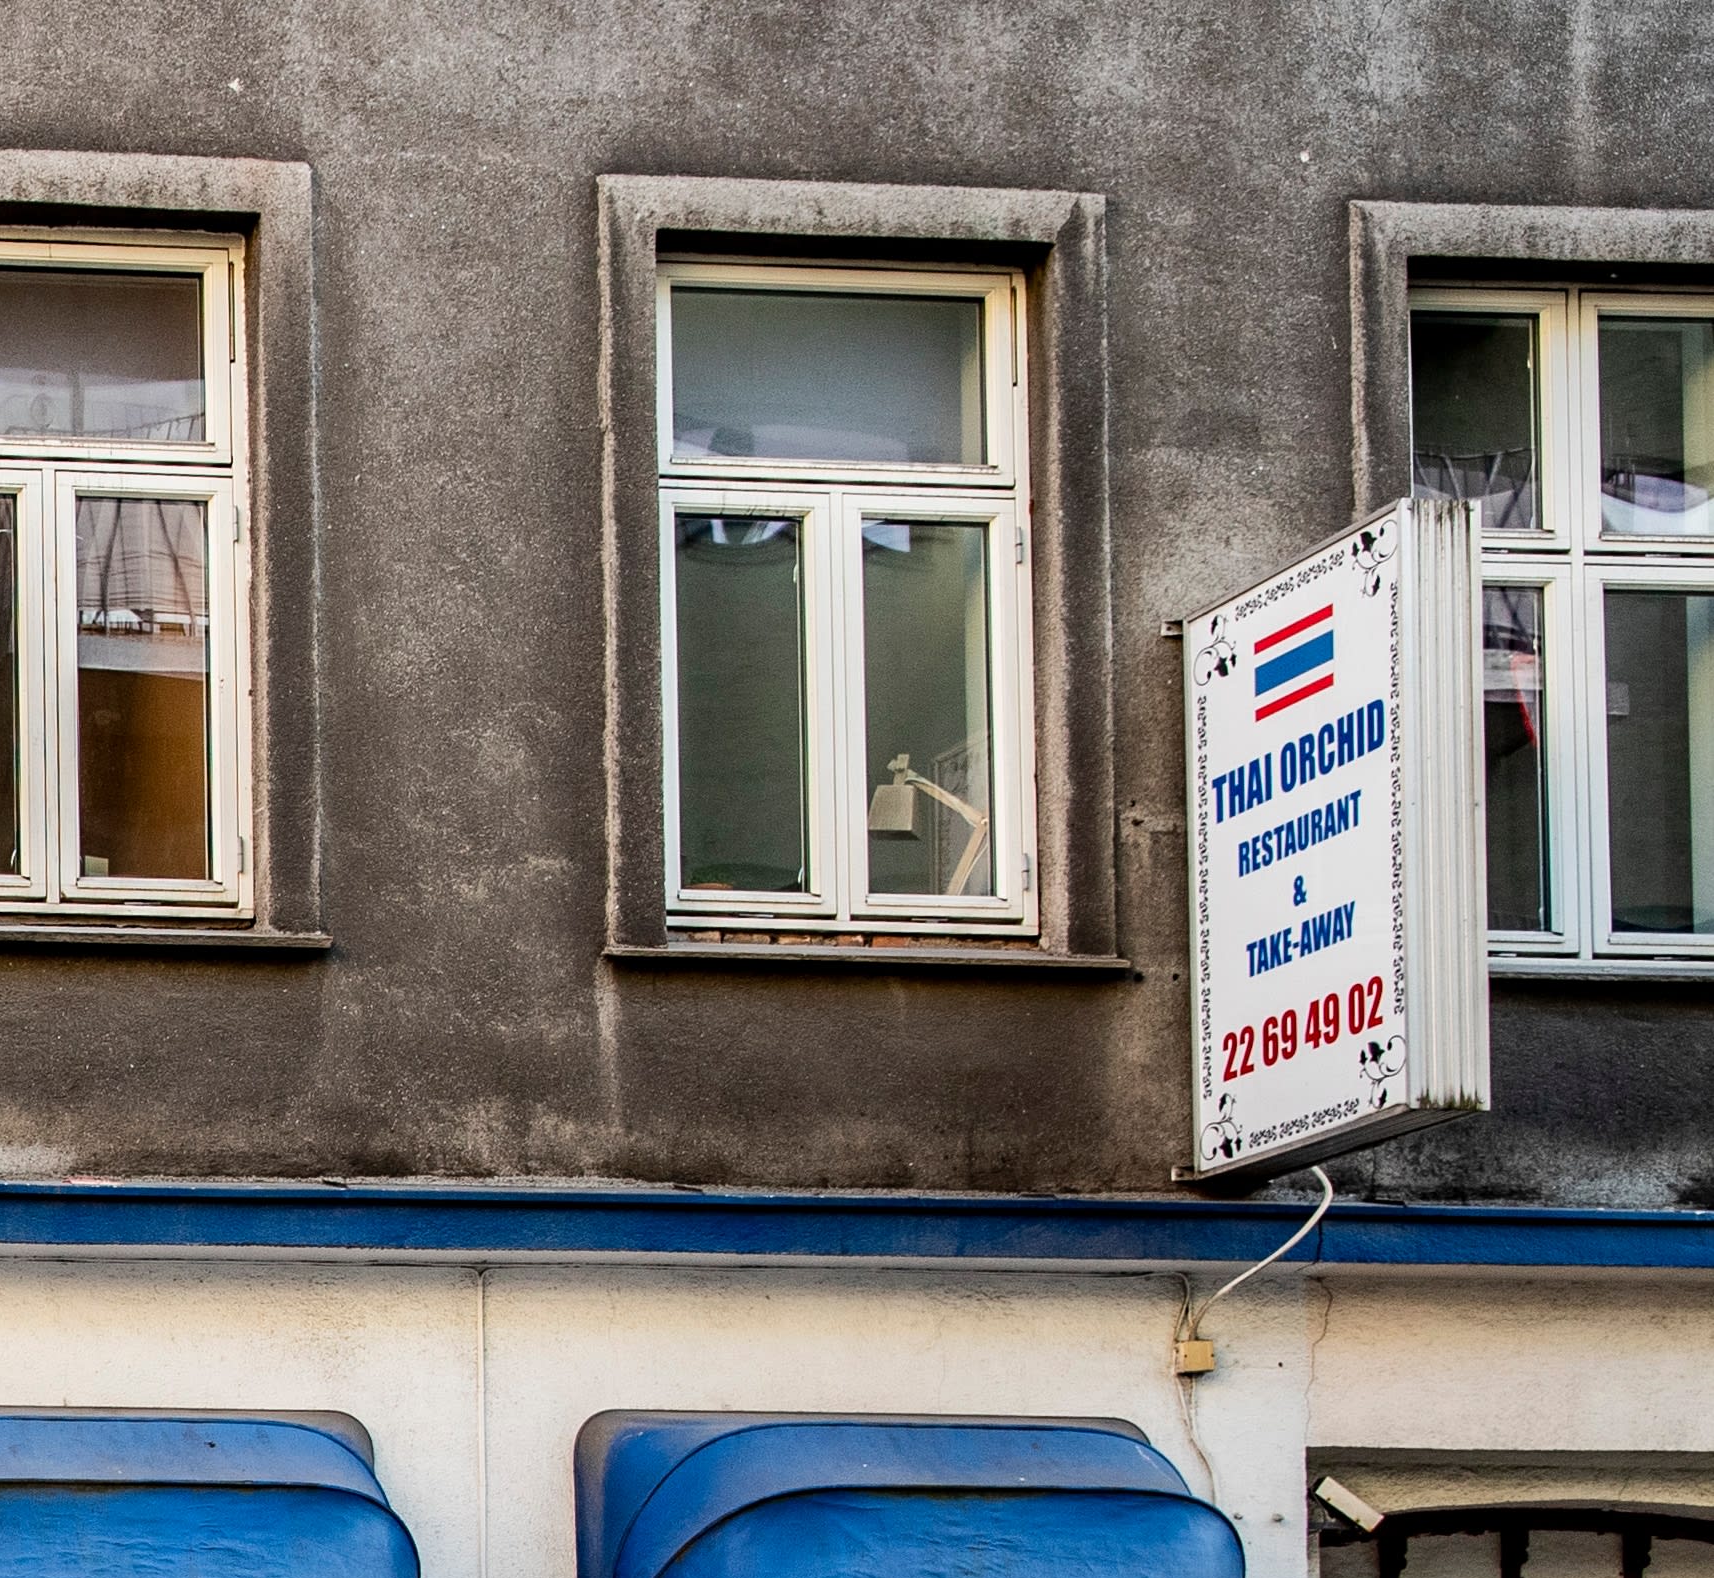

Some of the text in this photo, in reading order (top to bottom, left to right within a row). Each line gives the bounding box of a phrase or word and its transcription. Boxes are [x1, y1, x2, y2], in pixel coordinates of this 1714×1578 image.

[1212, 698, 1386, 823] THAI ORCHID
[1238, 788, 1362, 877] RESTAURANT
[1292, 874, 1308, 906] &
[1246, 900, 1356, 977] TAKE-AWAY
[1222, 975, 1384, 1082] 22 69 49 02
